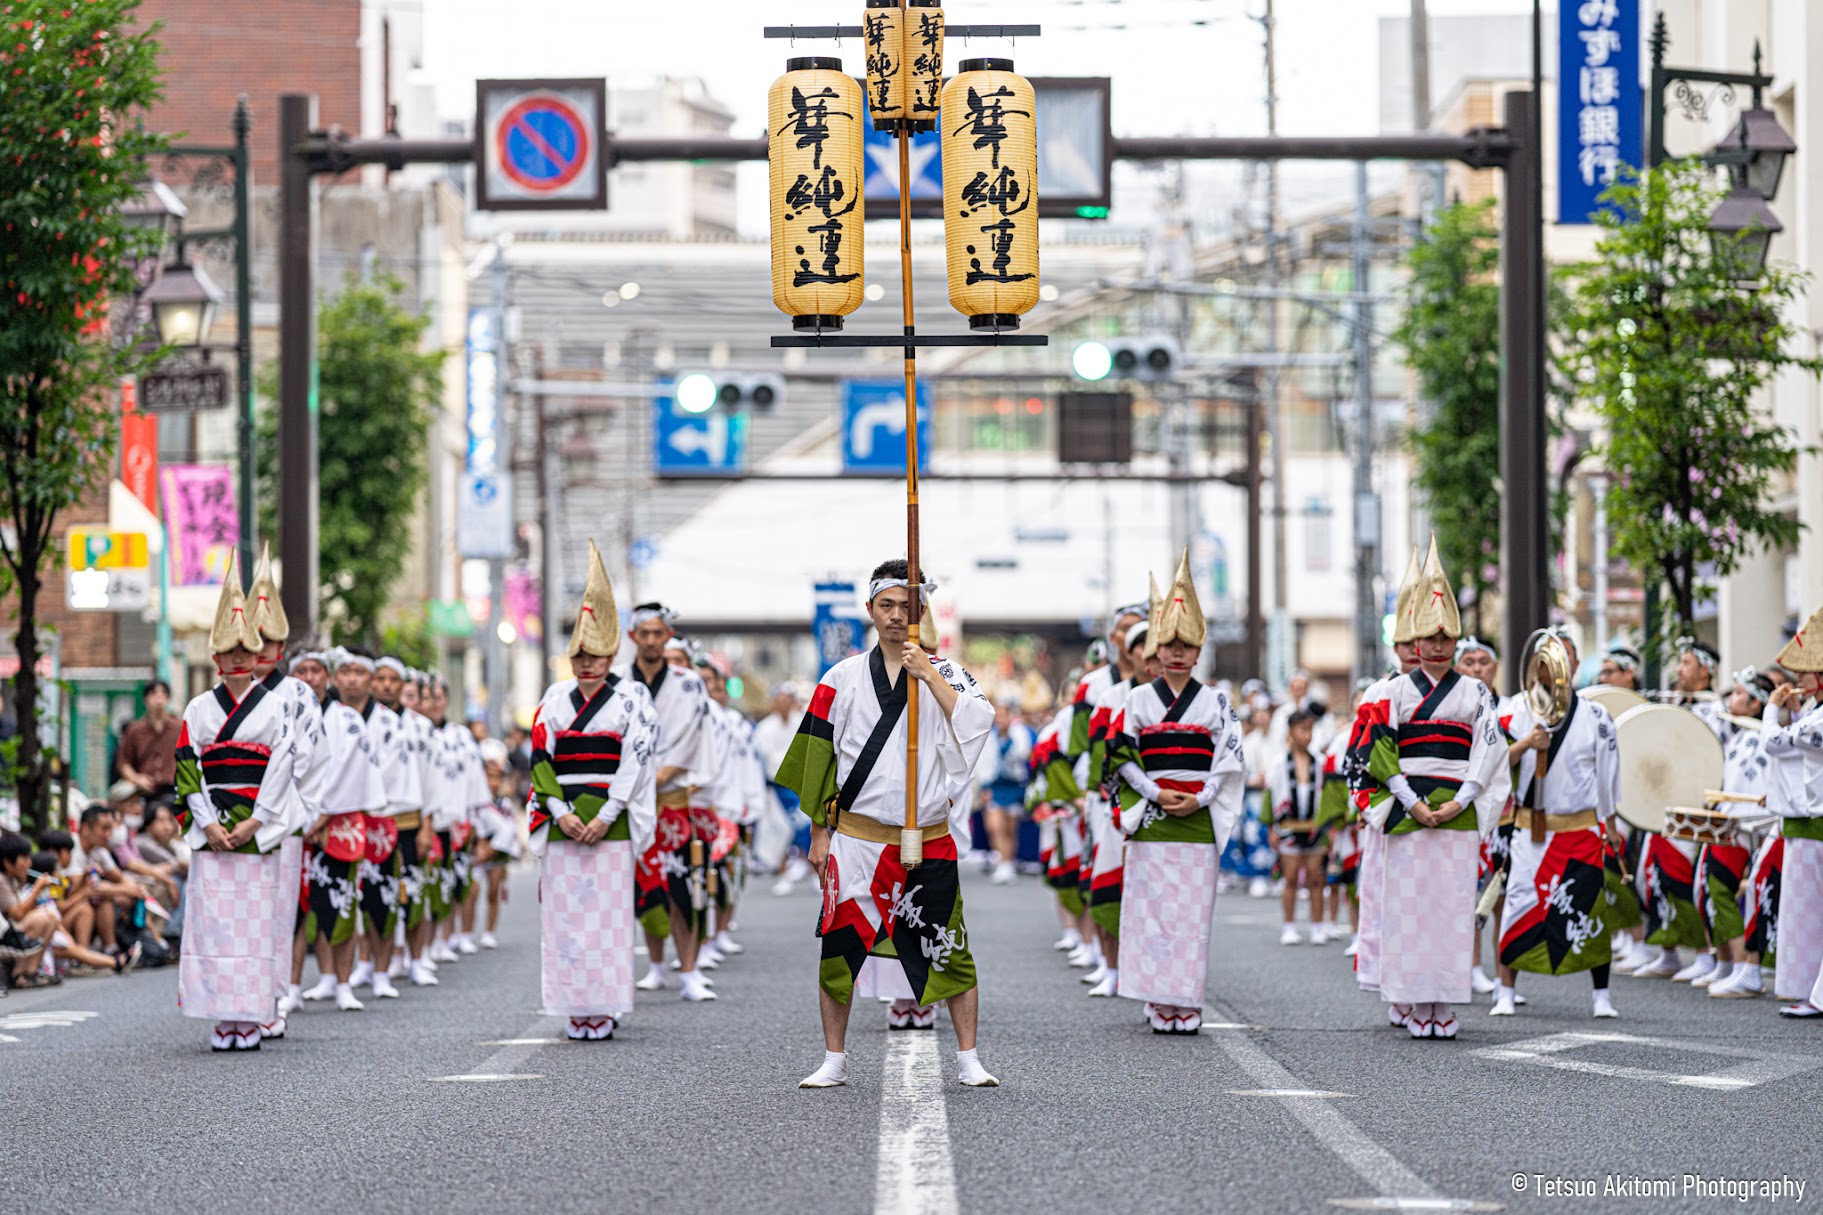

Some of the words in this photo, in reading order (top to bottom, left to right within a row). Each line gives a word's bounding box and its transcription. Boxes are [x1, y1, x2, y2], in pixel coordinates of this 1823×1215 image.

[777, 85, 862, 288] 華純連
[953, 85, 1036, 287] 華純連
[1578, 0, 1621, 187] みずほ銀行
